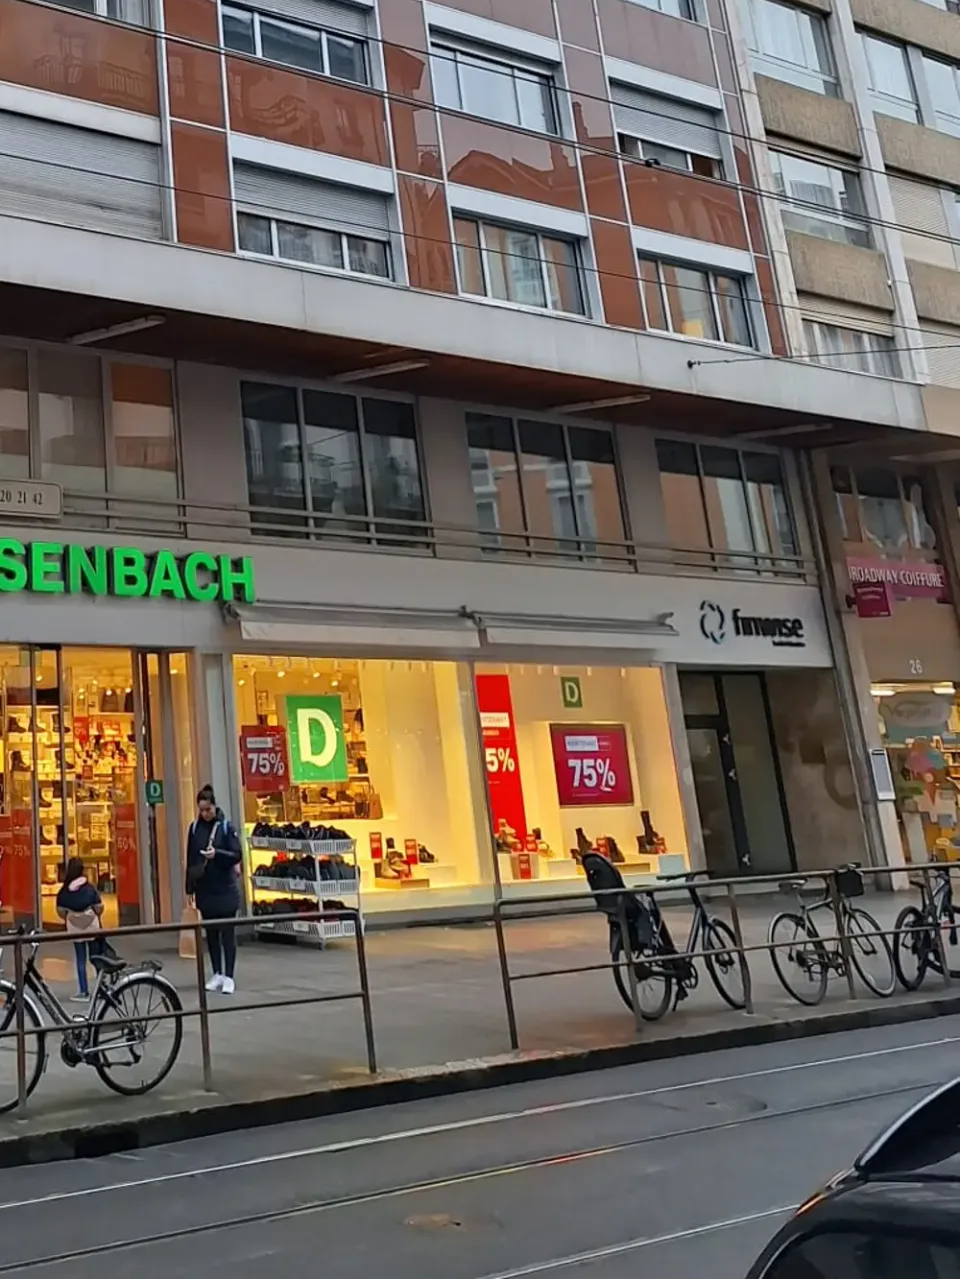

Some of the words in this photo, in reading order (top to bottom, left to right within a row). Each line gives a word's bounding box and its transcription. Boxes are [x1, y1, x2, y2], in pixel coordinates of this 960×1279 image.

[17, 491, 27, 504] 21
[32, 492, 44, 505] 42
[900, 570, 945, 588] COIFFURE
[909, 659, 923, 674] 26
[565, 681, 579, 703] D
[296, 707, 338, 768] D
[246, 751, 286, 776] 75%
[485, 747, 516, 773] 5%
[567, 757, 616, 788] 75%
[150, 782, 161, 797] D
